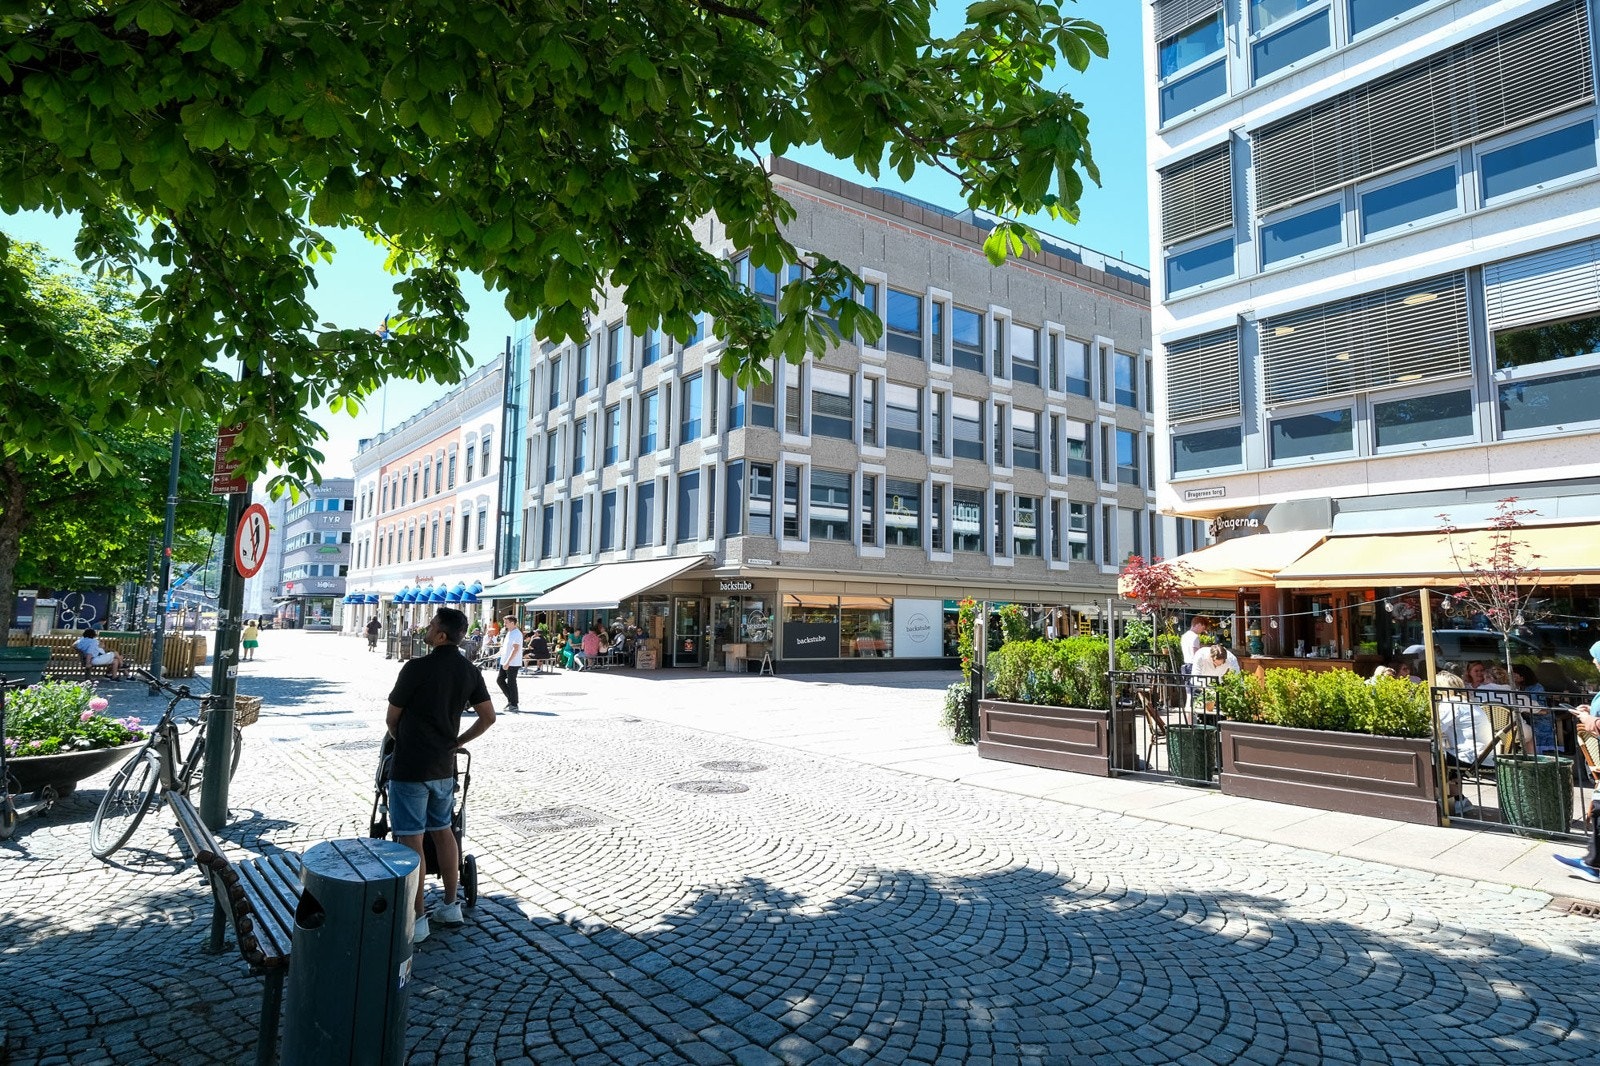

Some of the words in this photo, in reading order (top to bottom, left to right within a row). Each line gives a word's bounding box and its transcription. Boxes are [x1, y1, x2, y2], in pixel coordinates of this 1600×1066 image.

[720, 581, 752, 591] backstube
[1444, 604, 1477, 619] Caf
[796, 635, 827, 645] backstube
